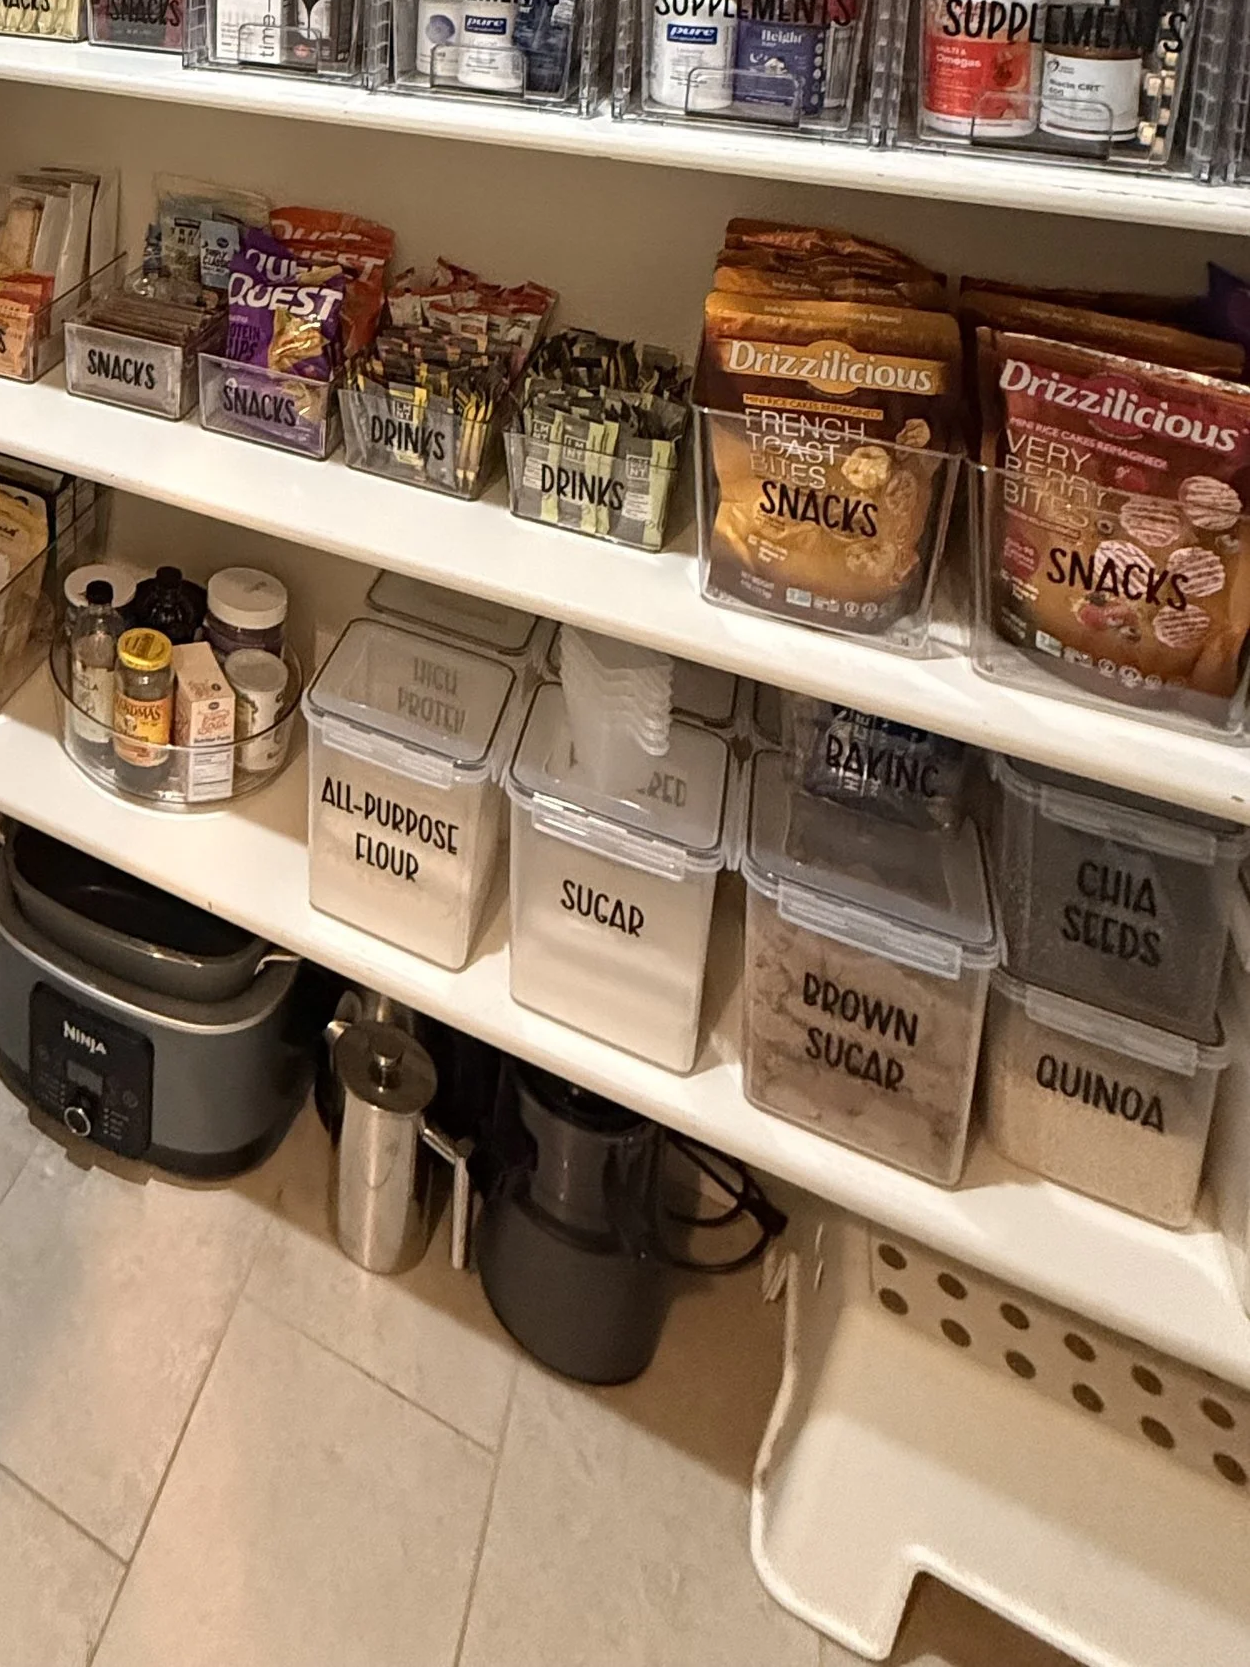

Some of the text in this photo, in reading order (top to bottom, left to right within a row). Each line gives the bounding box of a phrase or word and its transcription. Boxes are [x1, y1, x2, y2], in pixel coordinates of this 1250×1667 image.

[467, 17, 505, 28] pure
[670, 25, 716, 37] pure
[228, 271, 345, 322] QUEST
[87, 349, 156, 391] SNACKS
[728, 339, 932, 391] Drizzilicious
[222, 384, 296, 427] SNACKS
[745, 408, 866, 443] FRENCH
[999, 358, 1238, 453] Drizzilicious
[371, 415, 445, 461] DRINKS
[747, 432, 840, 466] TOAST
[1006, 428, 1092, 473] VERY
[541, 464, 624, 512] DRINKS
[751, 454, 826, 490] BITES
[760, 480, 879, 539] SNACKS
[1003, 478, 1089, 529] BITES
[1047, 547, 1190, 612] SNACKS
[825, 736, 940, 799] BAKING
[321, 777, 459, 855] ALL-PURPOSE
[356, 833, 420, 882] FLOUR
[560, 879, 645, 938] SUGAR
[1077, 860, 1158, 917] CHIA
[1062, 904, 1162, 968] SEEDS
[803, 971, 919, 1048] BROWN
[805, 1026, 905, 1093] SUGAR
[1036, 1054, 1165, 1134] QUINOA
